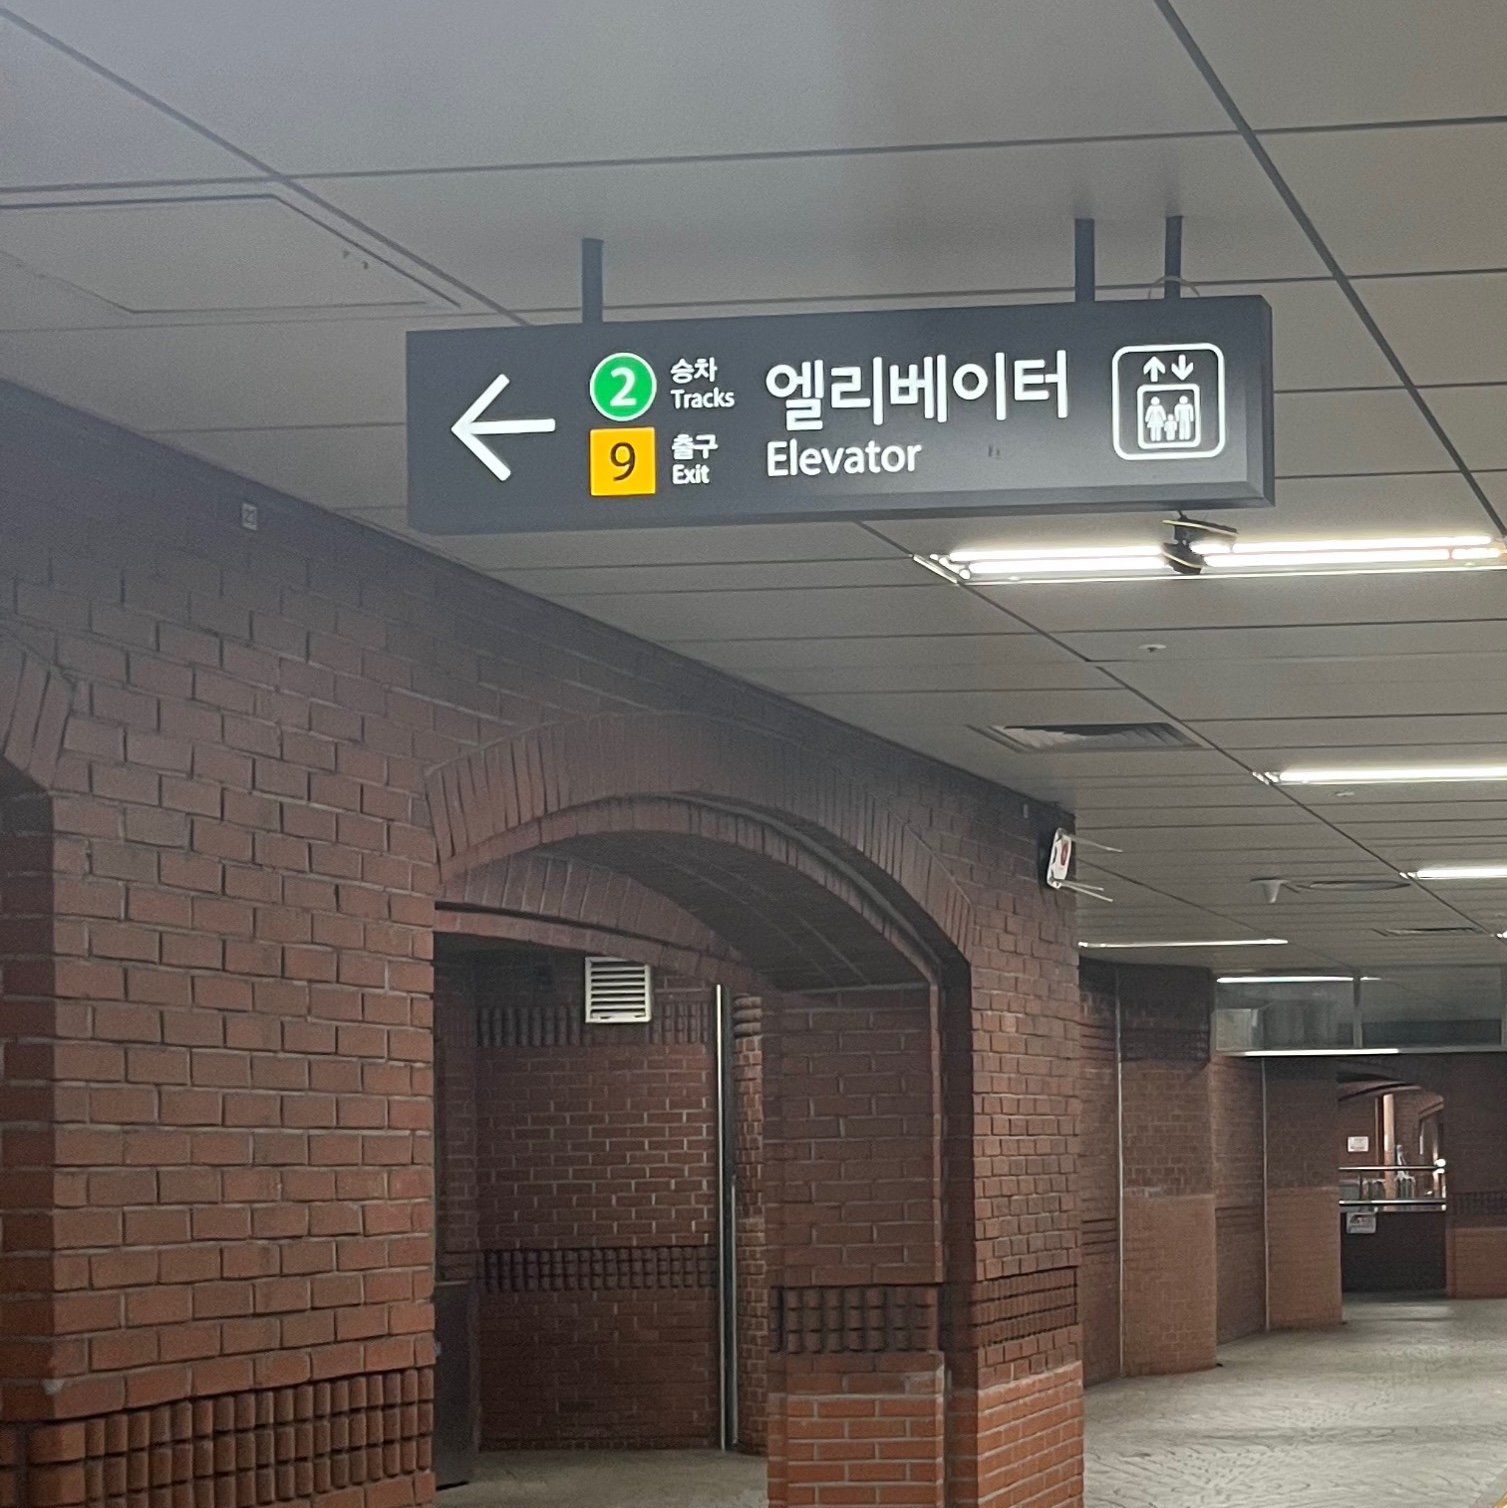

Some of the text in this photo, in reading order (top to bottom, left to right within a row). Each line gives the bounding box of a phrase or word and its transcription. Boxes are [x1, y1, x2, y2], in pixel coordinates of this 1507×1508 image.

[609, 366, 637, 408] 2
[670, 357, 718, 385] 승차
[670, 386, 736, 410] Tracks
[765, 349, 1068, 431] 엘리베이터
[609, 440, 637, 483] 9
[671, 433, 719, 460] 출구
[766, 438, 922, 477] Elevator
[672, 463, 710, 485] Exit
